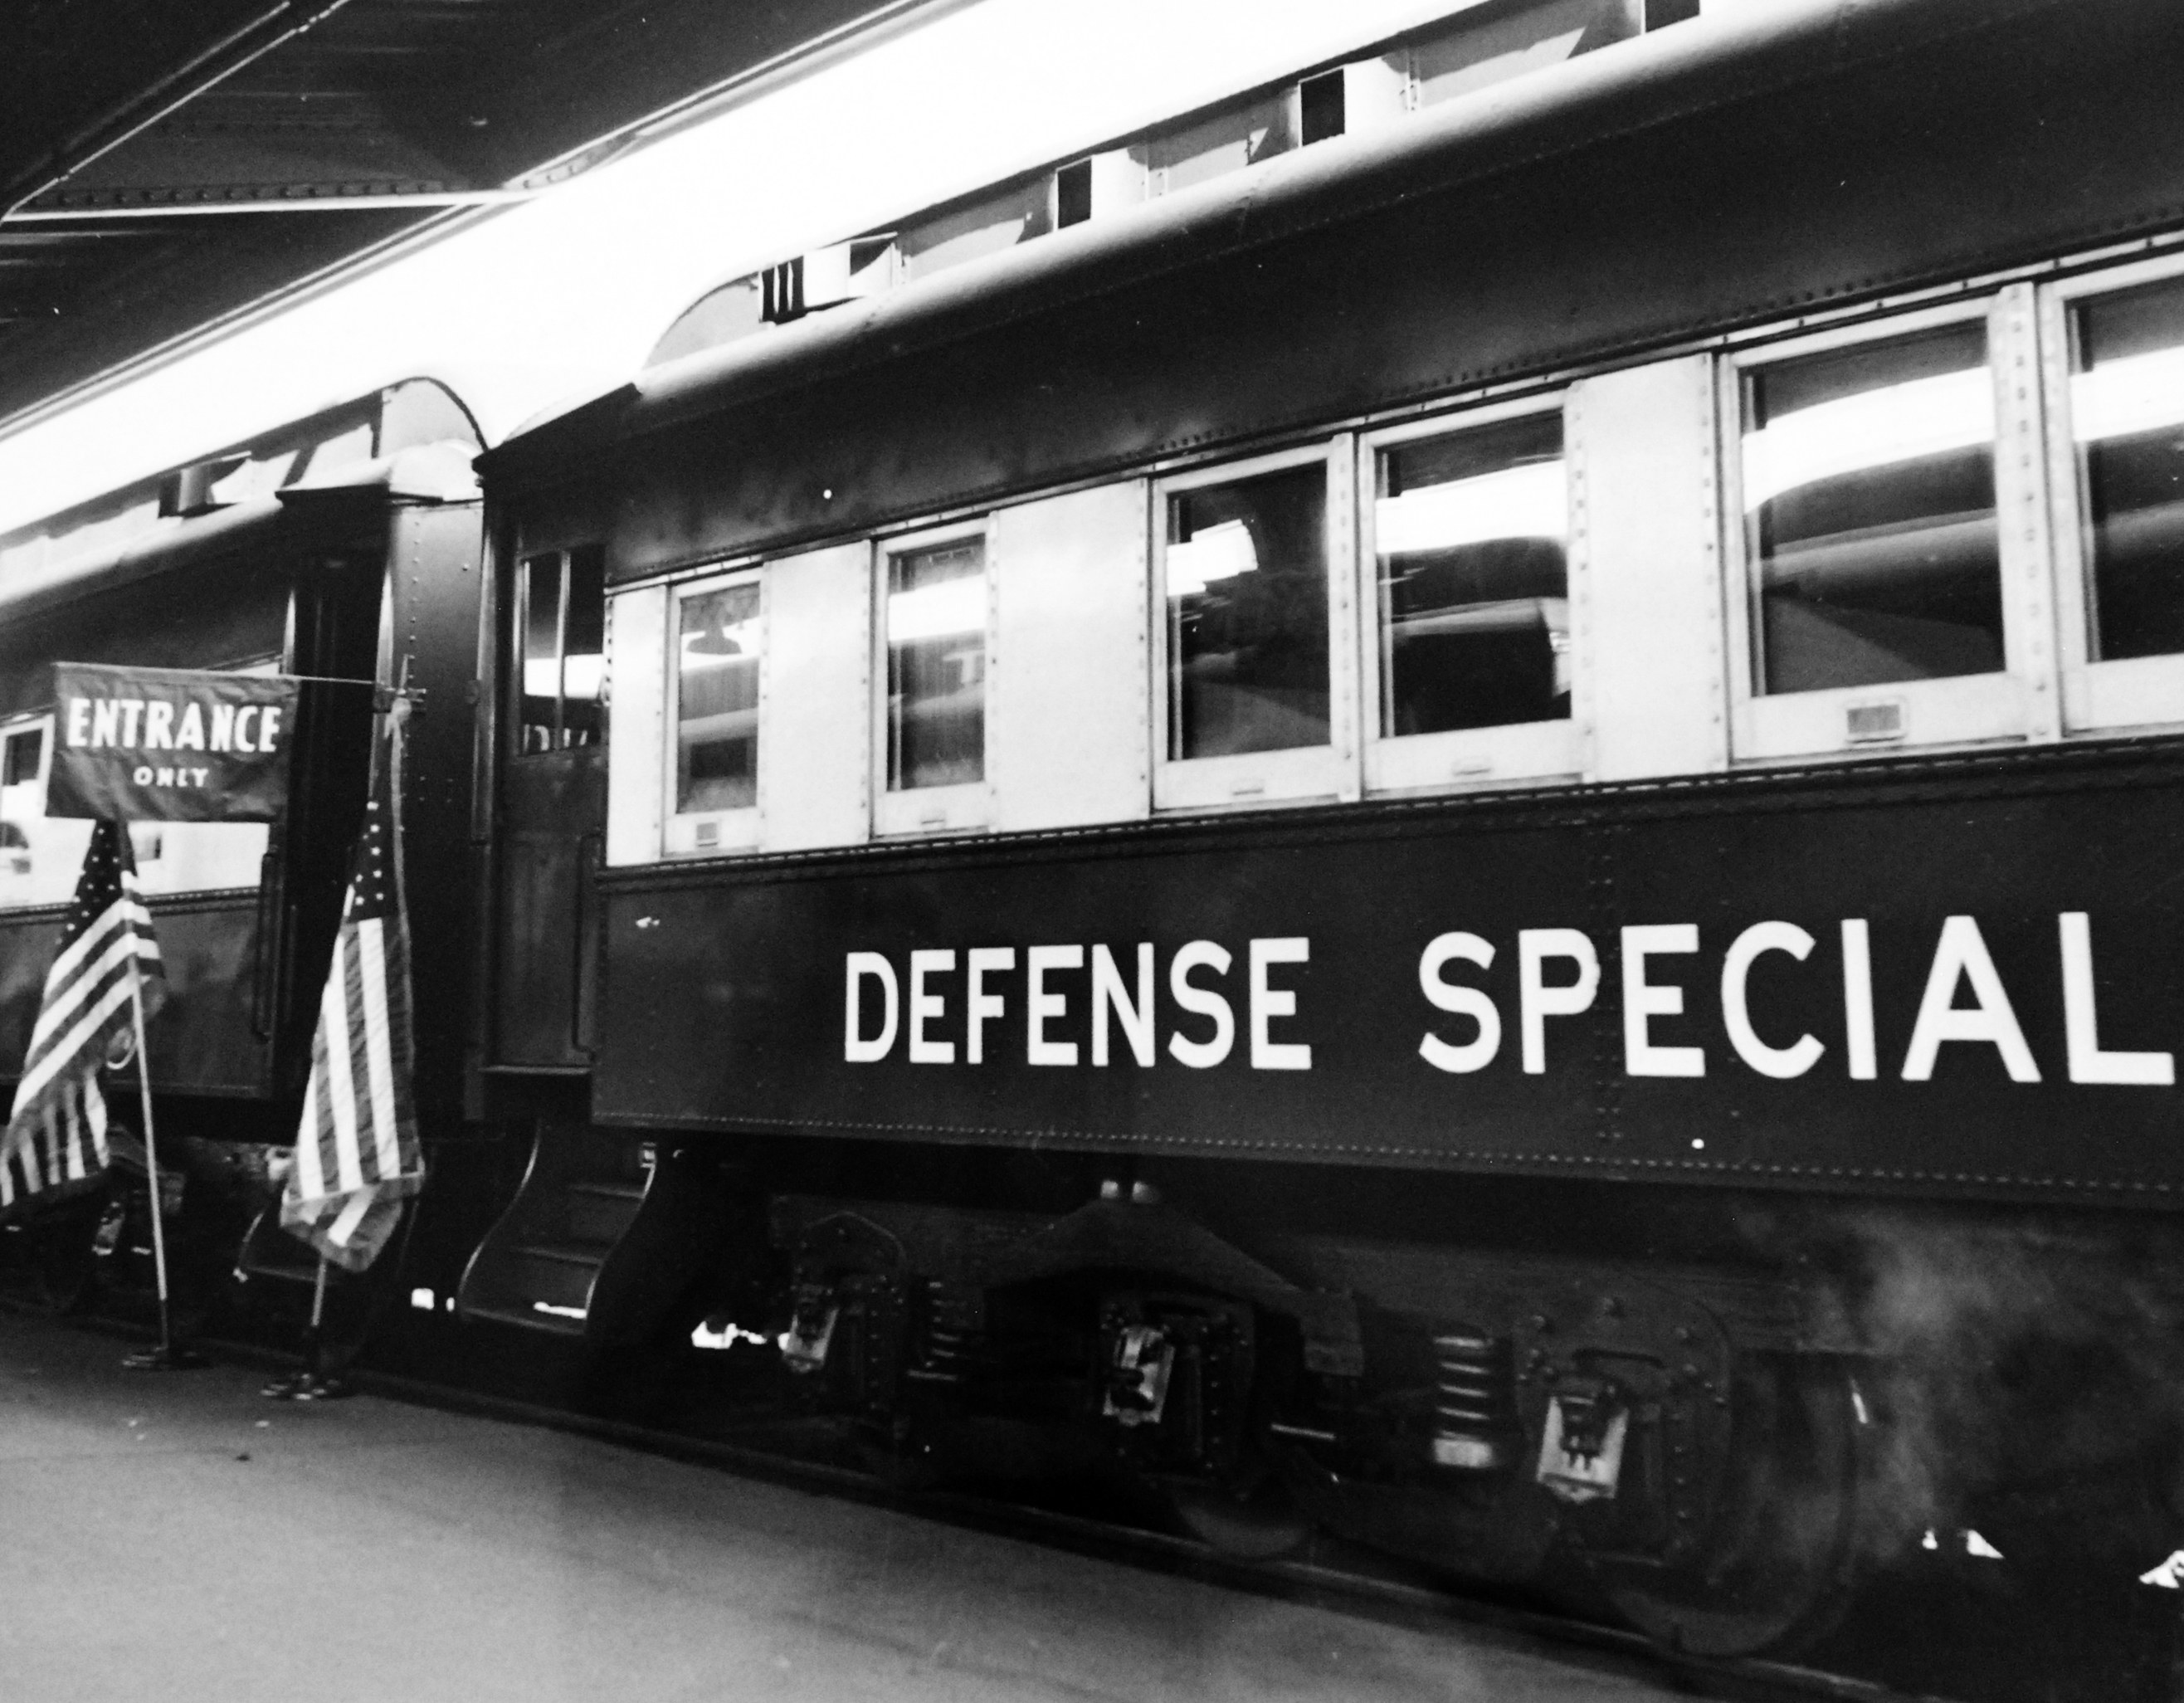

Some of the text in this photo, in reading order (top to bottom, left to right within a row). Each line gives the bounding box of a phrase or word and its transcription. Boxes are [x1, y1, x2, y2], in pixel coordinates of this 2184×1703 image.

[66, 696, 282, 753] ENTRANCE
[133, 765, 209, 788] ONLY
[844, 911, 2176, 1086] DEFENSE SPECIAL
